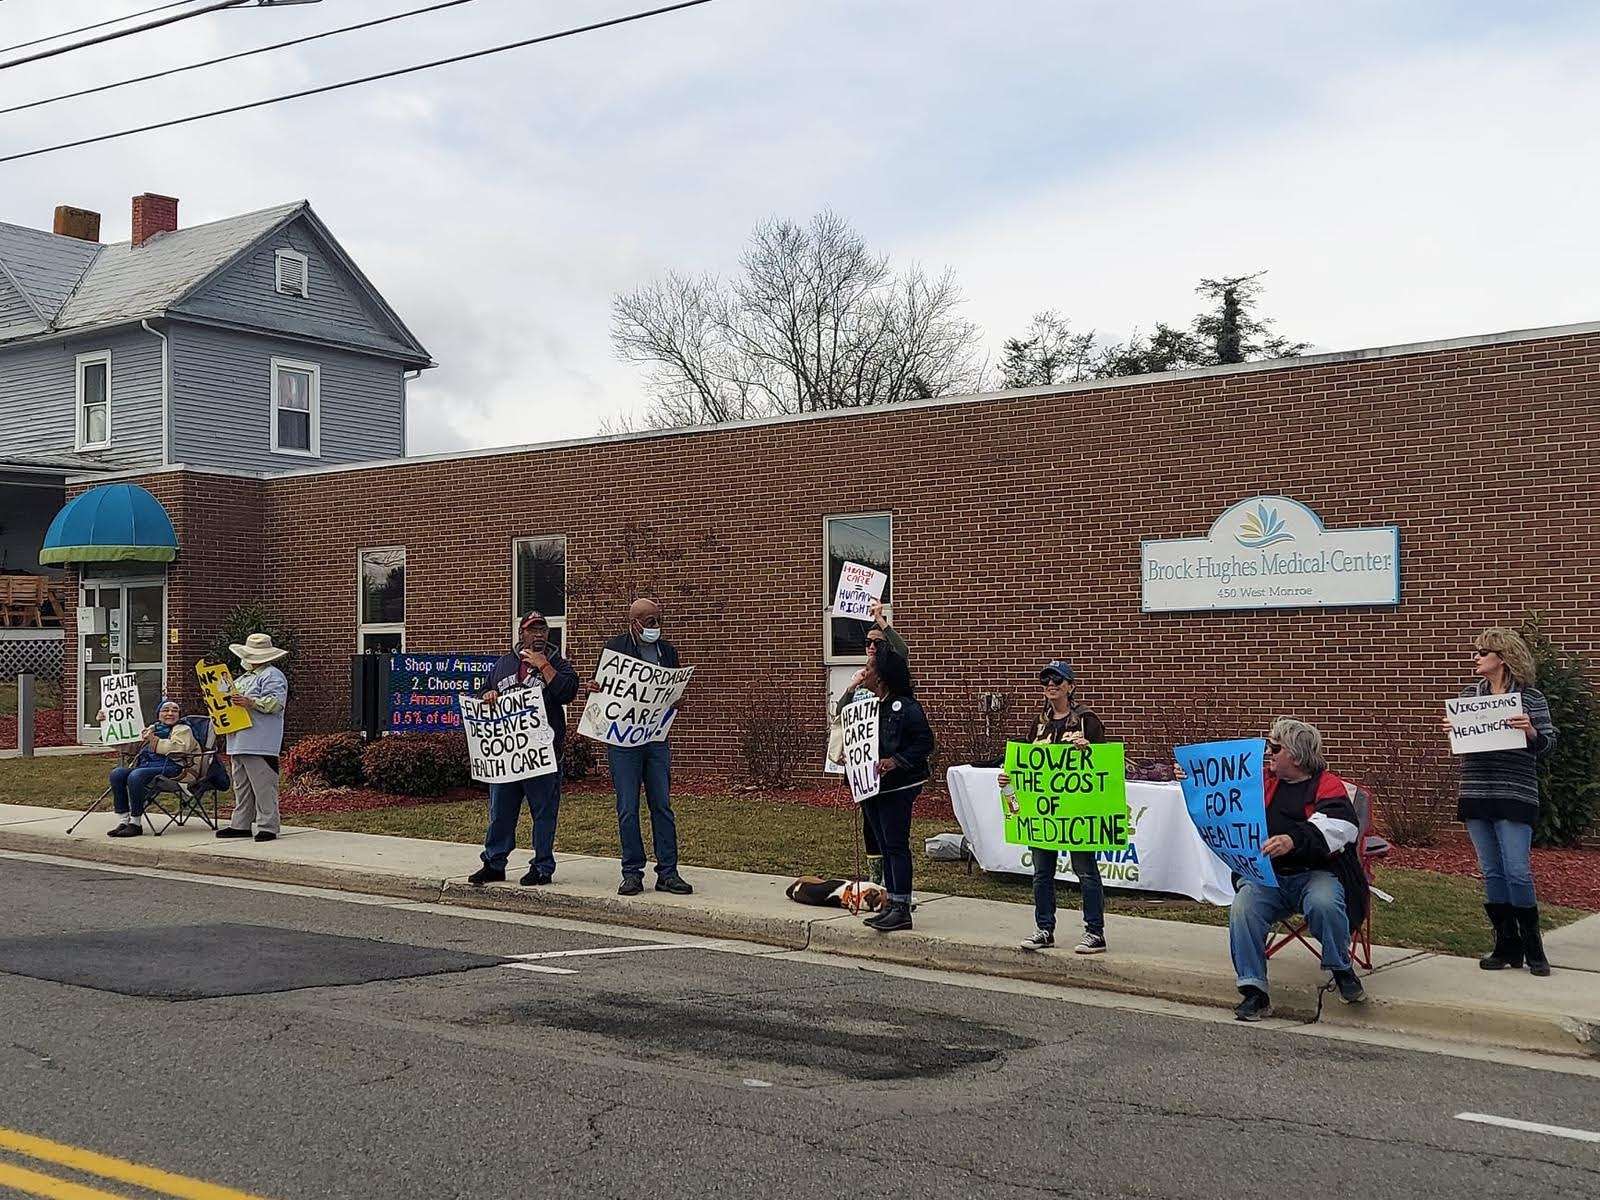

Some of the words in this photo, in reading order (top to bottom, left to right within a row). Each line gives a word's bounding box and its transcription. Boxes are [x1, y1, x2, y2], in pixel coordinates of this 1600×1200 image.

[1148, 558, 1194, 580] Brock
[1197, 555, 1257, 584] Hughes
[1261, 551, 1325, 575] Medical
[1331, 550, 1391, 573] Center
[839, 589, 871, 602] HUMAN
[1217, 588, 1236, 598] 450
[1240, 587, 1266, 597] West
[1269, 586, 1312, 596] Monroe
[390, 658, 400, 671] 1.
[405, 658, 432, 674] Shop
[436, 659, 450, 671] w/
[602, 655, 693, 685] AFFORDABLE
[103, 674, 137, 692] HEALTH
[411, 677, 423, 690] 2.
[428, 677, 469, 690] Choose
[600, 676, 674, 704] HEALTH
[104, 690, 135, 708] CARE
[409, 692, 453, 705] Amazon
[1448, 696, 1517, 716] VIRGINIANS
[109, 707, 134, 722] FOR
[393, 711, 422, 724] 0.5%
[427, 711, 439, 724] of
[471, 711, 541, 738] DESERVES
[605, 702, 662, 725] CARE
[843, 701, 880, 728] HEALTH
[106, 722, 140, 742] ALL
[606, 707, 675, 744] NOW!
[844, 722, 874, 746] CARE
[480, 733, 529, 757] GOOD
[849, 743, 872, 767] FOR
[473, 758, 506, 777] HEALTH
[510, 747, 551, 774] CARE
[1016, 746, 1095, 771] LOWER
[1189, 752, 1252, 787] HONK
[1011, 770, 1045, 793] THE
[1050, 771, 1109, 793] COST
[1036, 796, 1060, 816] OF
[1205, 788, 1243, 818] FOR
[1017, 814, 1126, 845] MEDICINE
[1200, 822, 1261, 850] HEALTH
